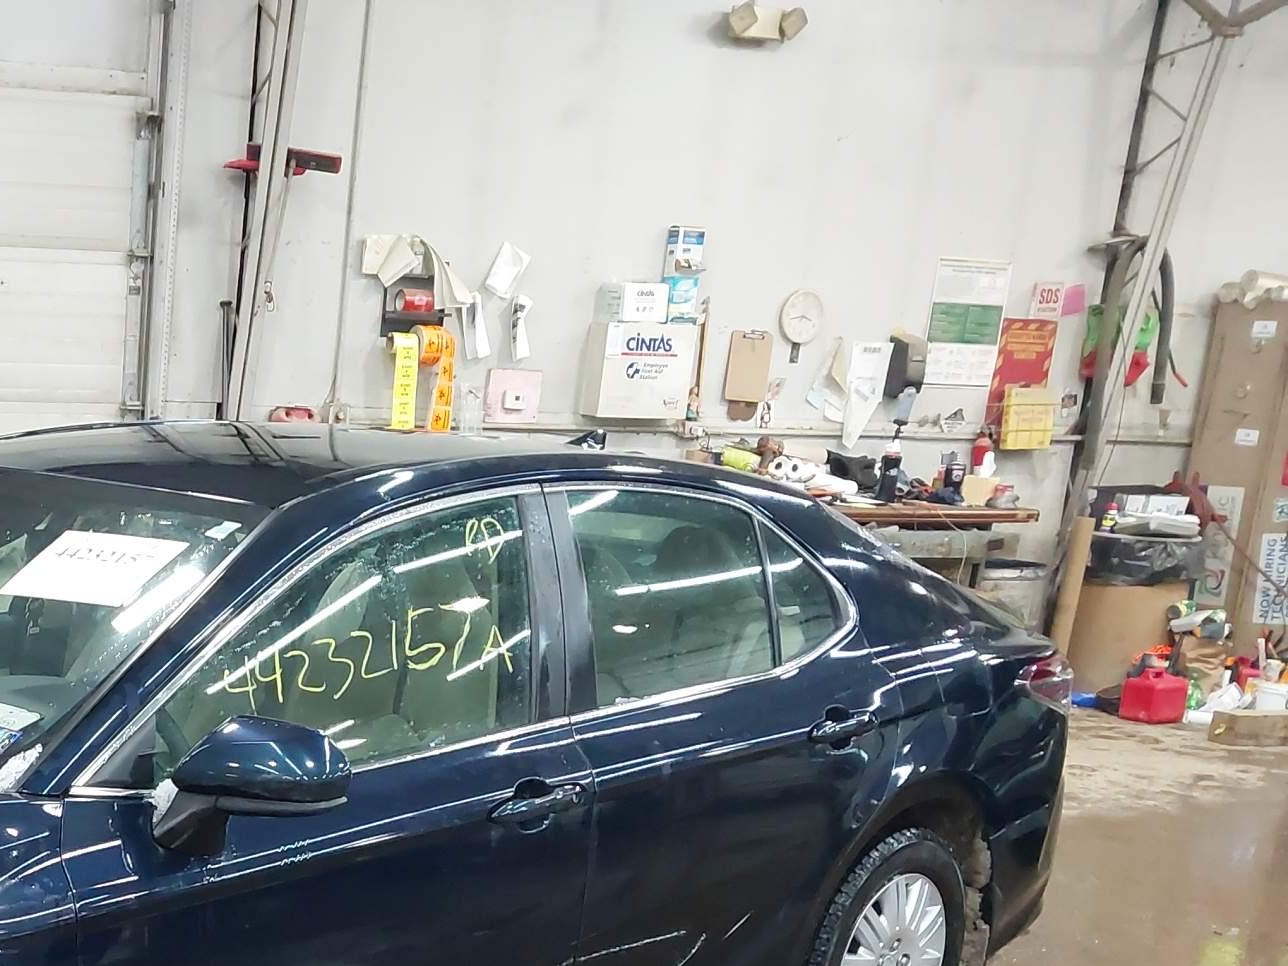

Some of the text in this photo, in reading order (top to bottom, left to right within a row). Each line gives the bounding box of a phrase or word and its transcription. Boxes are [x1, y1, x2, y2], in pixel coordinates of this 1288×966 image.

[1039, 288, 1061, 304] SDS
[1271, 536, 1288, 621] TECNICIANS
[1259, 587, 1271, 618] NOW
